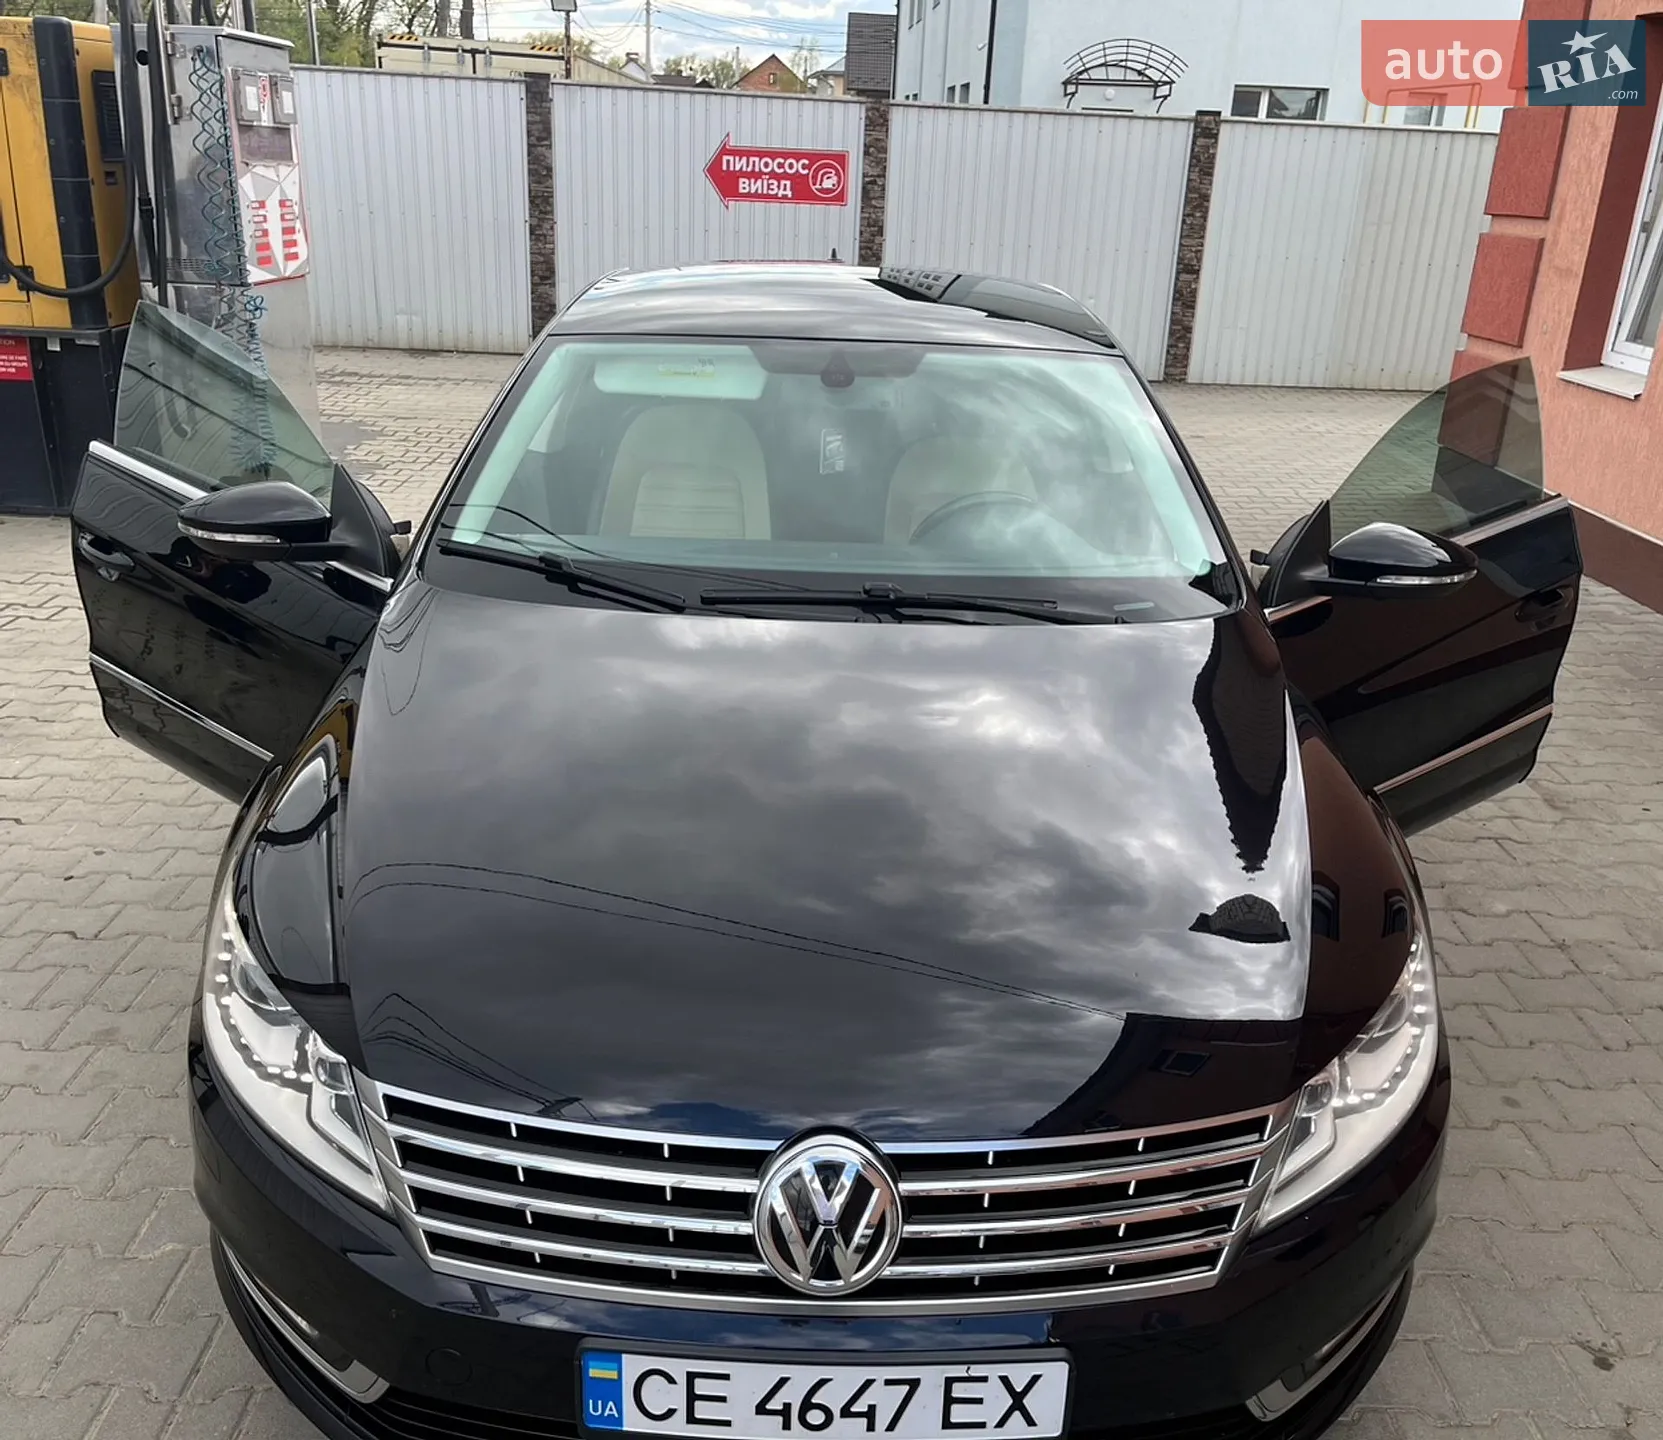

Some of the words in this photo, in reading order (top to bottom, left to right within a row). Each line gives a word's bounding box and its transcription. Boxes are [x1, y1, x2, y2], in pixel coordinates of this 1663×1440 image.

[722, 155, 809, 174] ПИЛОСОС
[738, 175, 792, 197] ВИЇЗД
[589, 1400, 618, 1417] UA
[632, 1368, 732, 1427] CE
[754, 1376, 921, 1432] 4647
[941, 1374, 1043, 1430] EX
